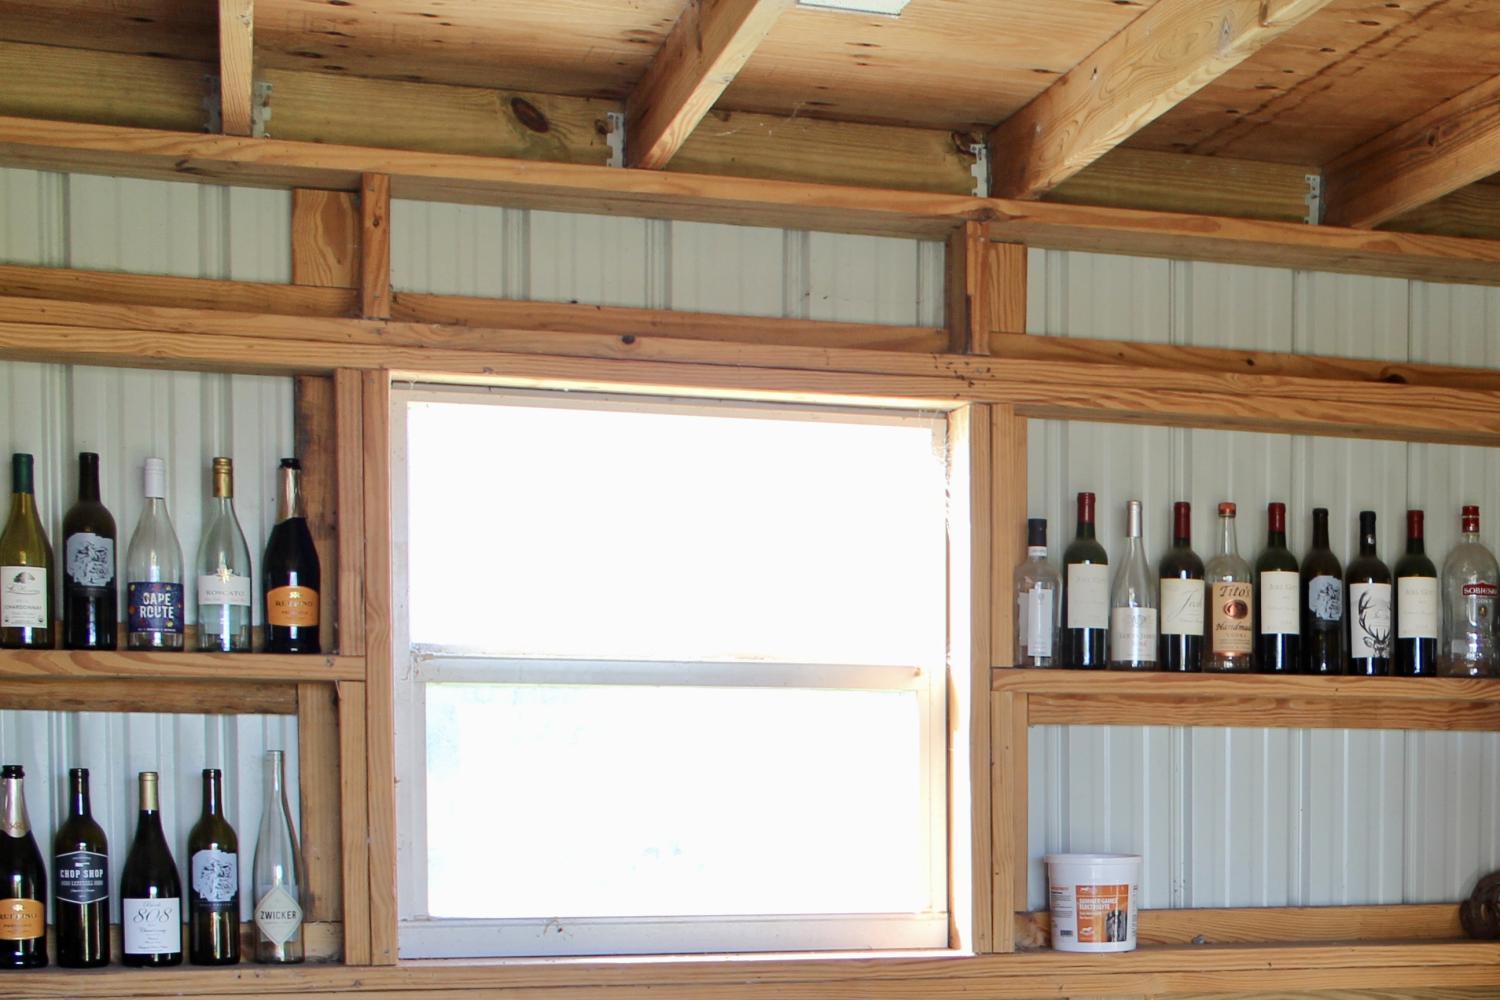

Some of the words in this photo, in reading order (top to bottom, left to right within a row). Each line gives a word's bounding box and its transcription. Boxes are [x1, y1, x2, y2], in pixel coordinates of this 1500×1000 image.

[143, 593, 171, 605] CAPE
[140, 606, 174, 618] ROUTE
[60, 869, 80, 878] CHOP
[83, 869, 104, 878] SHOP
[260, 910, 297, 920] ZWICKER
